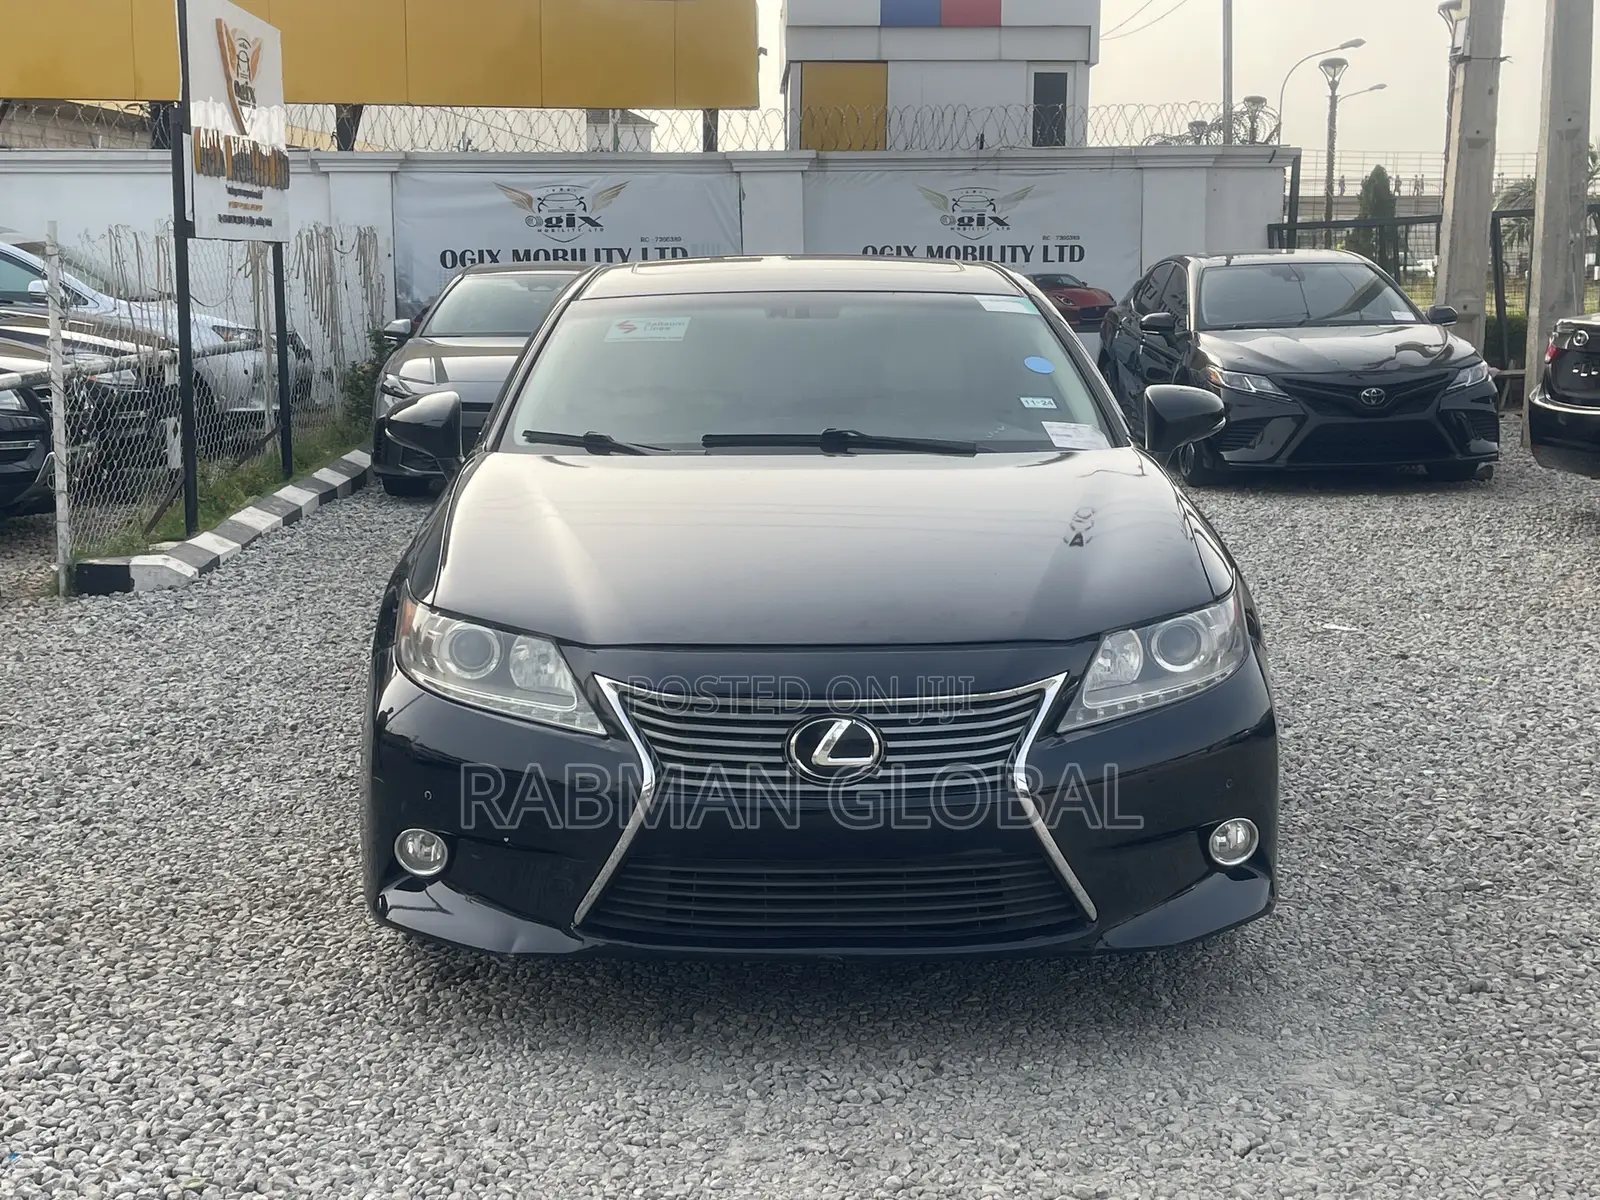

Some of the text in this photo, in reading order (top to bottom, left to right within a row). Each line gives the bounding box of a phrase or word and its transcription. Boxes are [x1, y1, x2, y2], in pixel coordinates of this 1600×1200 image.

[440, 249, 501, 269] OGIX
[926, 245, 1034, 263] MOBILITY
[1042, 244, 1085, 263] LTD
